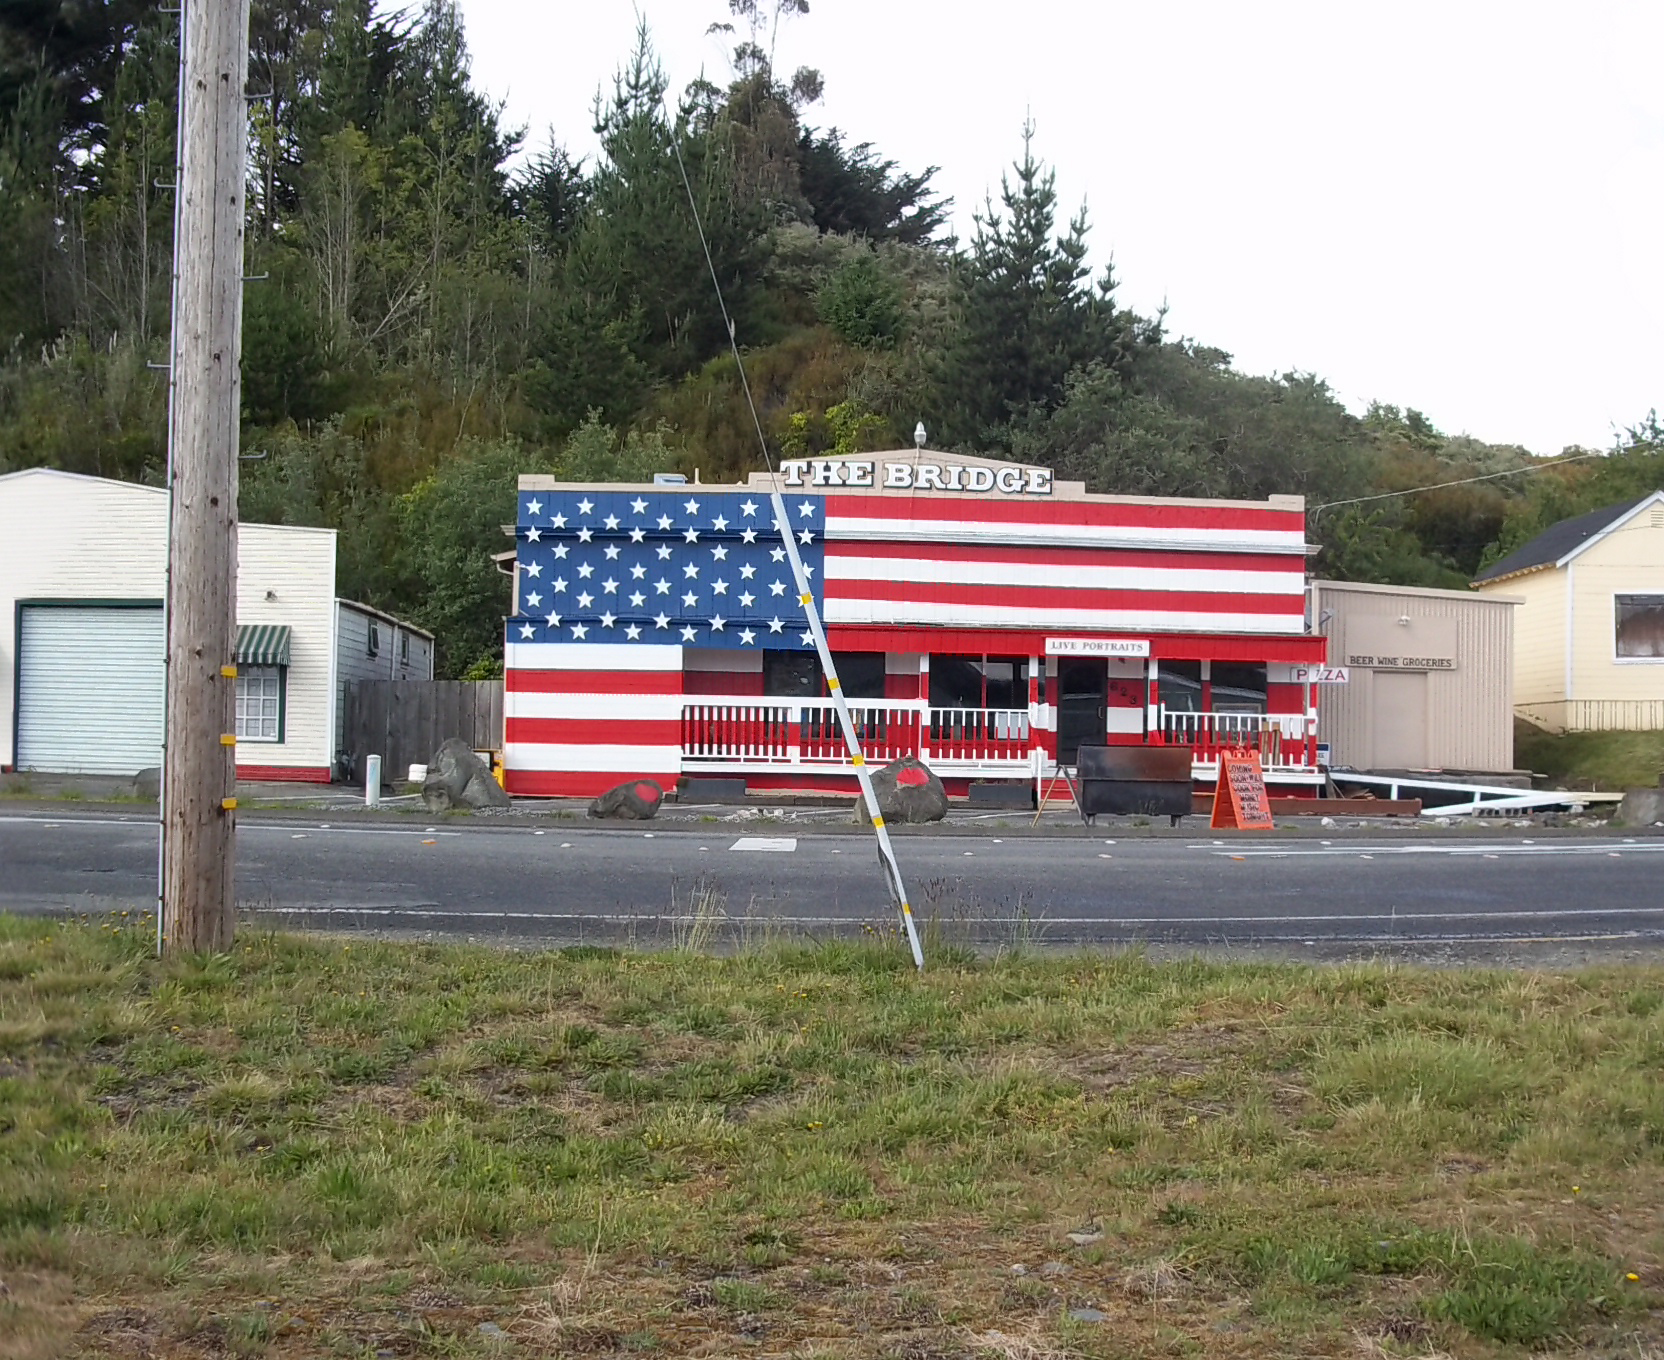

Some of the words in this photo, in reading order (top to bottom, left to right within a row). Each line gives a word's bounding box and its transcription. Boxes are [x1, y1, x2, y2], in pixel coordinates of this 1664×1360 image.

[780, 461, 875, 487] THE
[883, 462, 1054, 495] BRIDGE
[1051, 641, 1077, 650] LIVE
[1082, 641, 1144, 652] PORTRAITS
[1349, 655, 1374, 665] BEER
[1377, 656, 1399, 666] WINE
[1402, 657, 1452, 668] GROCERIES
[1296, 669, 1346, 681] PZA
